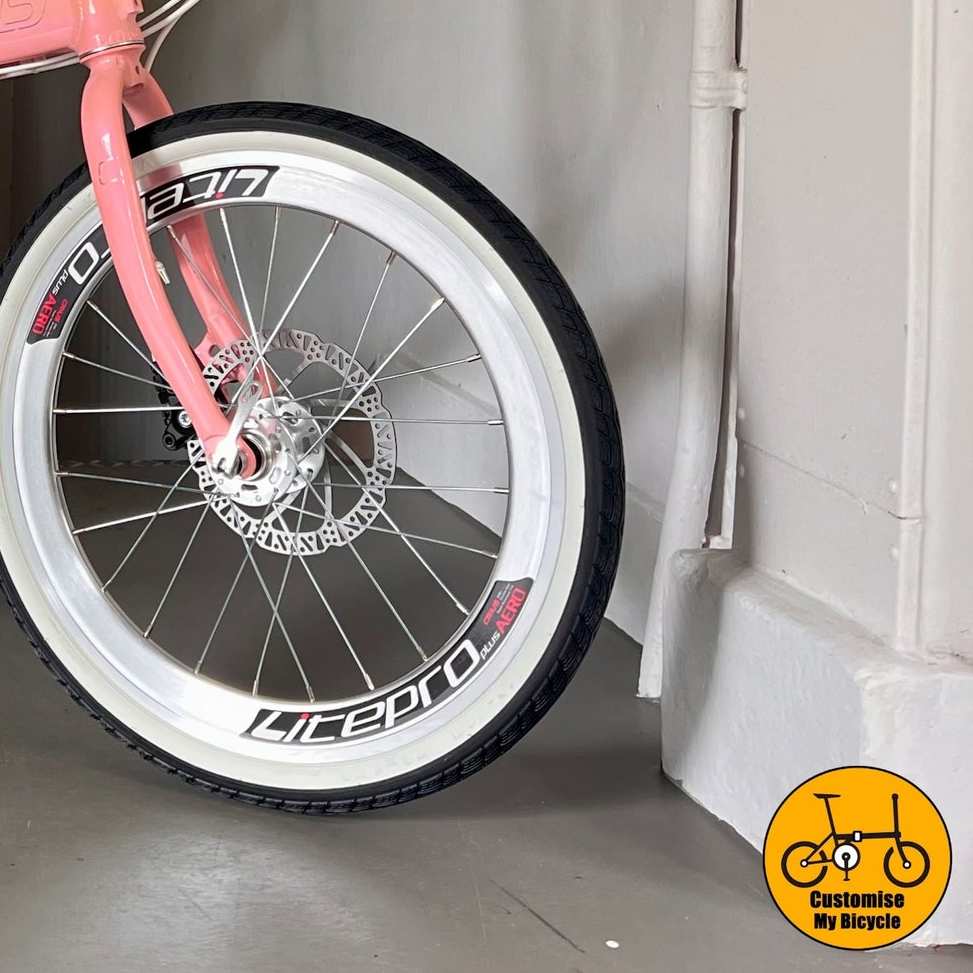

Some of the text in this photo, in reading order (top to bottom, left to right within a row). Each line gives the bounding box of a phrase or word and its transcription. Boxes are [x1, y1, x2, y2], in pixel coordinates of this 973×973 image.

[68, 168, 269, 285] Liteo
[32, 293, 57, 335] AERO
[251, 638, 478, 744] Litepro
[496, 587, 526, 634] AERO
